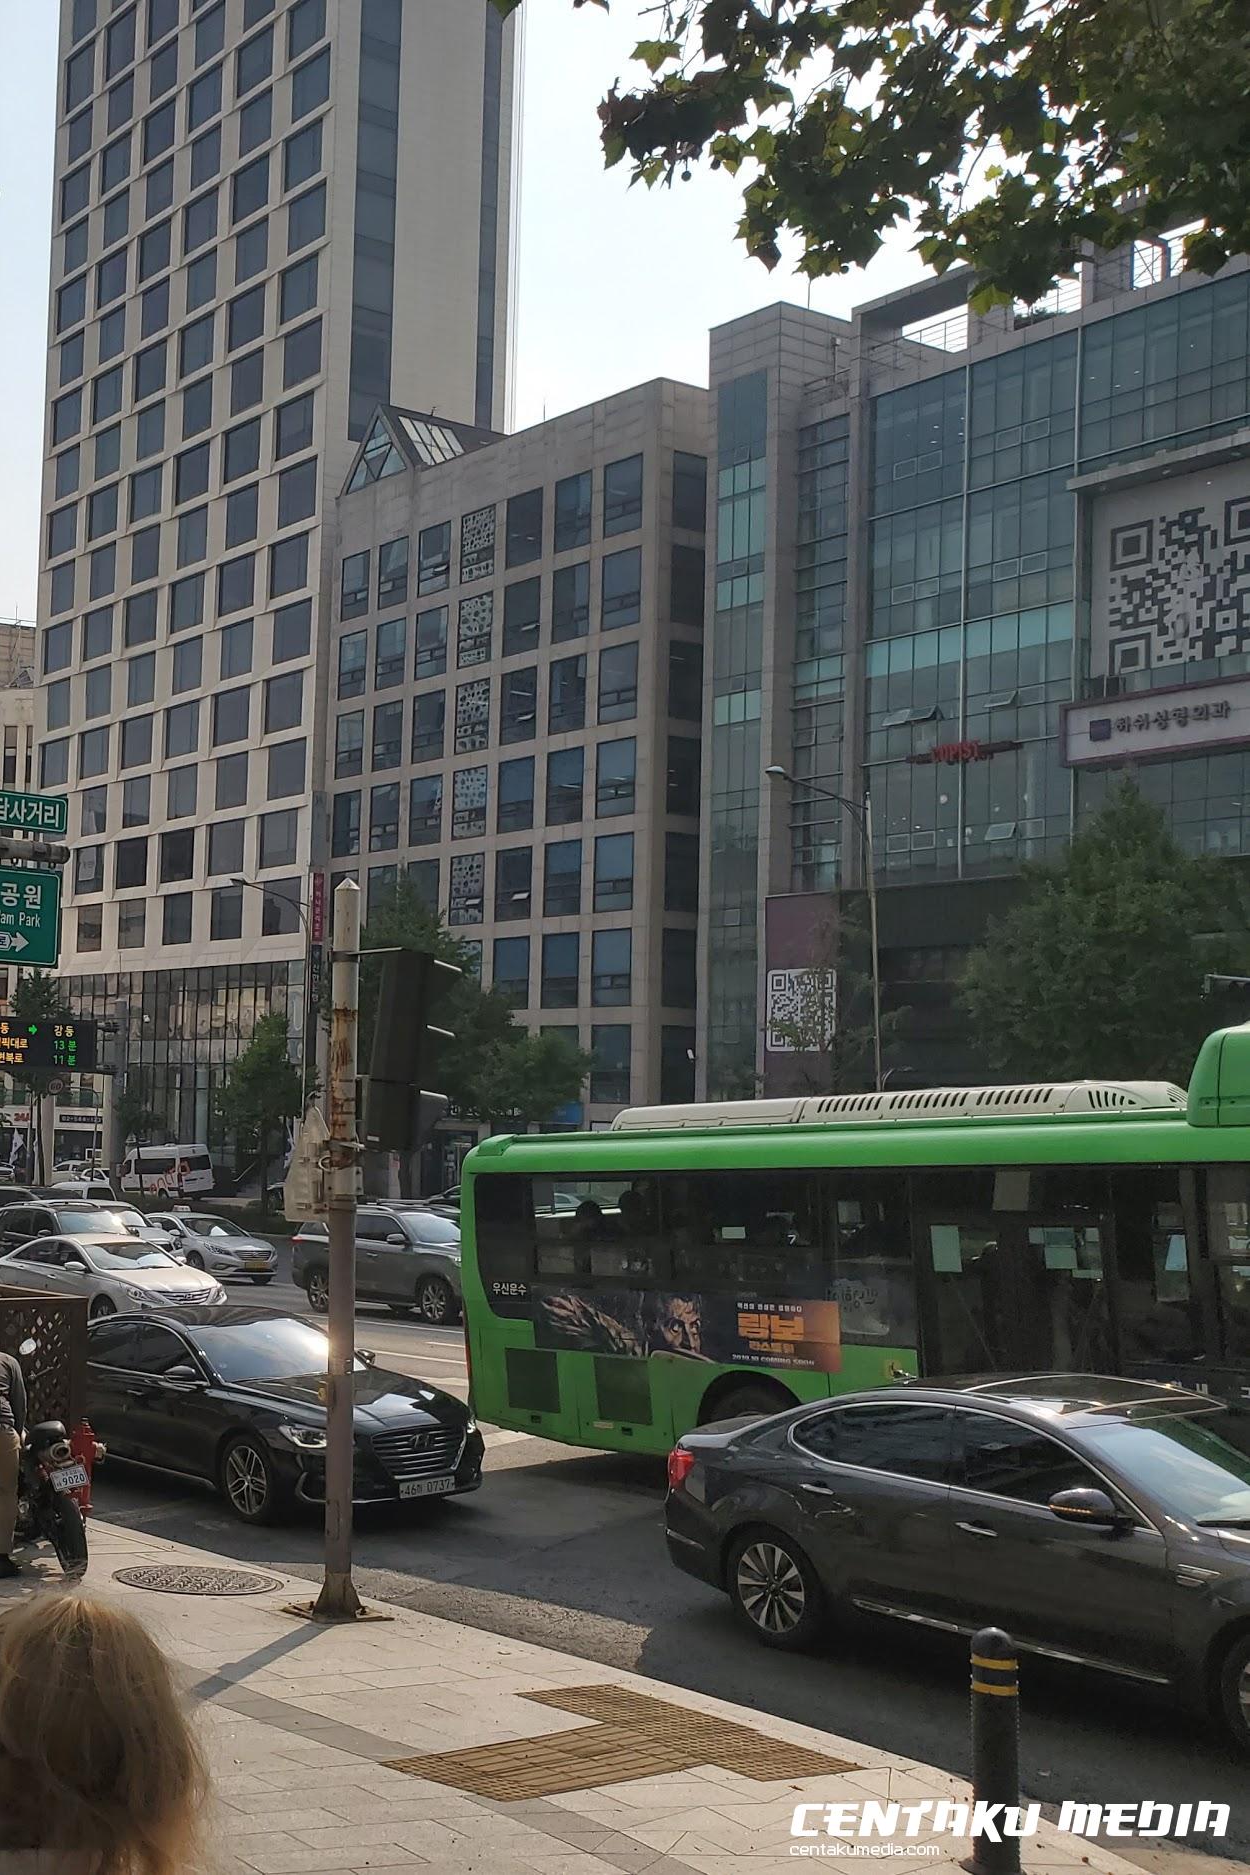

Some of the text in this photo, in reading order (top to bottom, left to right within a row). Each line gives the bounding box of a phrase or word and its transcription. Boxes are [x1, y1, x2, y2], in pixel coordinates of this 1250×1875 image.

[18, 911, 41, 928] Park
[53, 1040, 65, 1050] 13
[53, 1055, 64, 1065] 11
[492, 1282, 527, 1296] 우신운수
[62, 1473, 85, 1486] 9020
